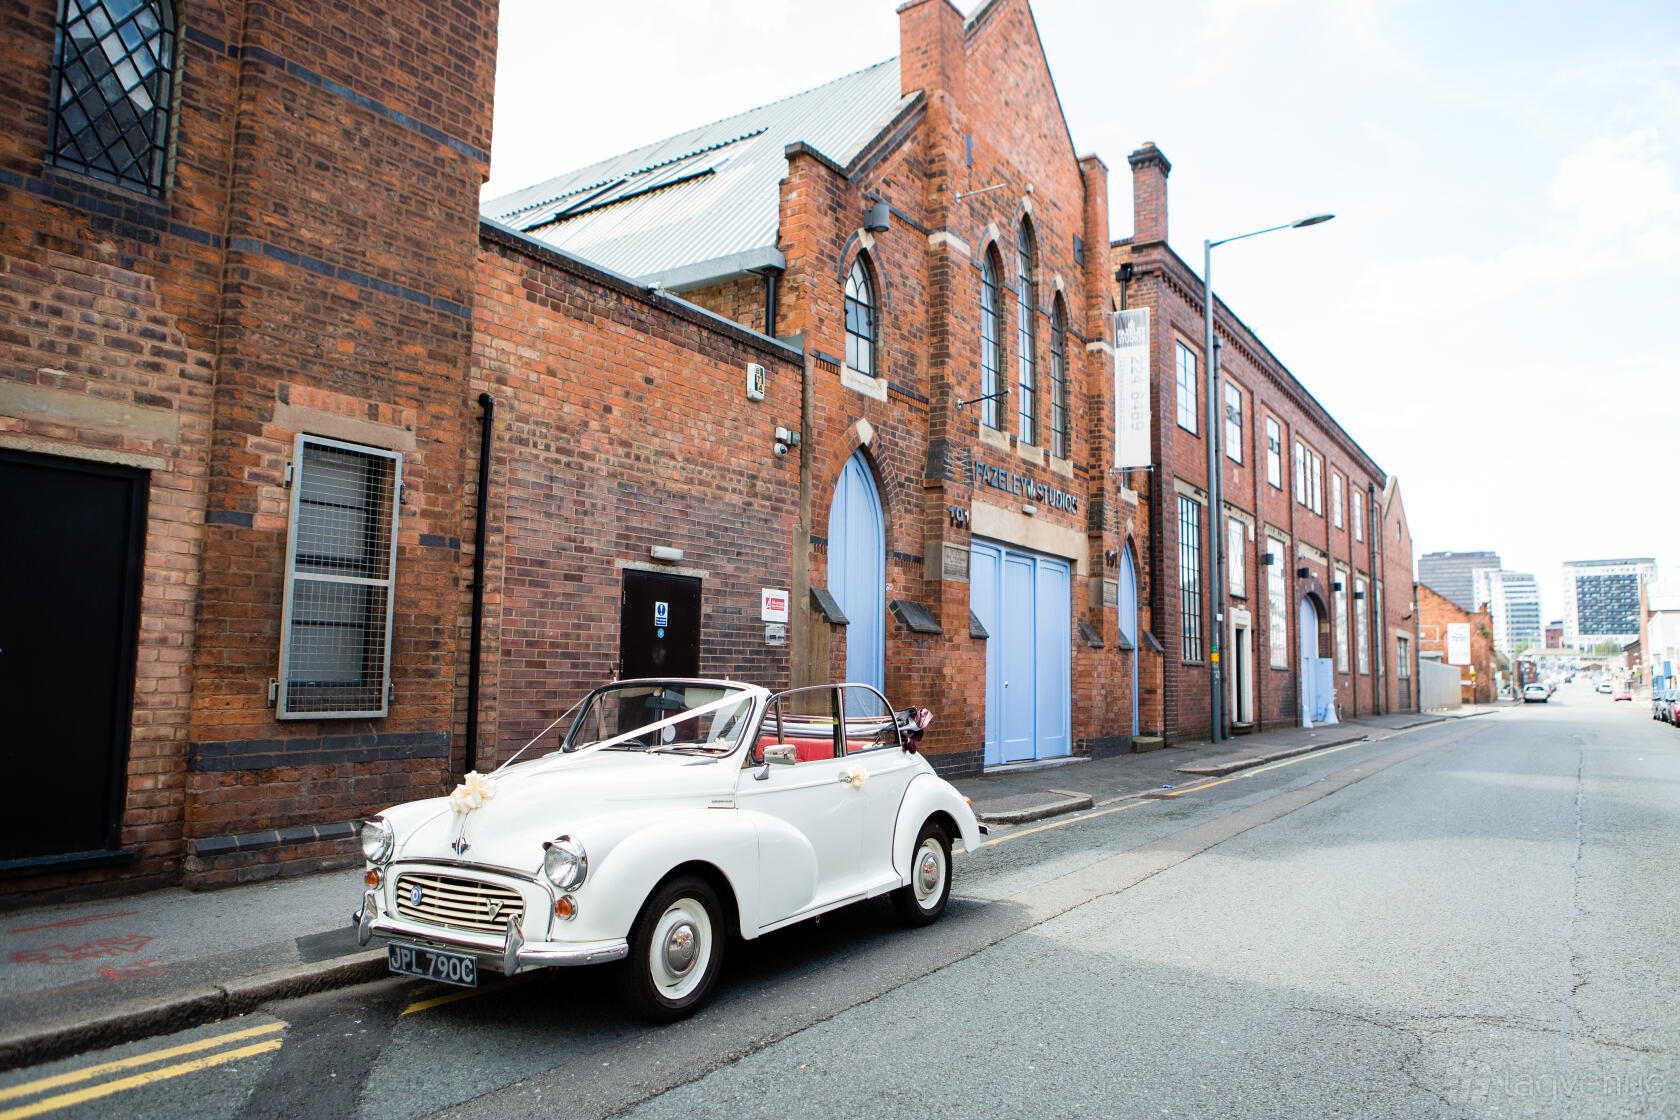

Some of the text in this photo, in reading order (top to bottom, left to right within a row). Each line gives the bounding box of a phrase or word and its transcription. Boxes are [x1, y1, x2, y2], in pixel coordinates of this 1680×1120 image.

[975, 460, 1078, 515] FAZELEY STUDIOS
[949, 504, 970, 530] 191
[391, 947, 474, 983] JPL 790C
